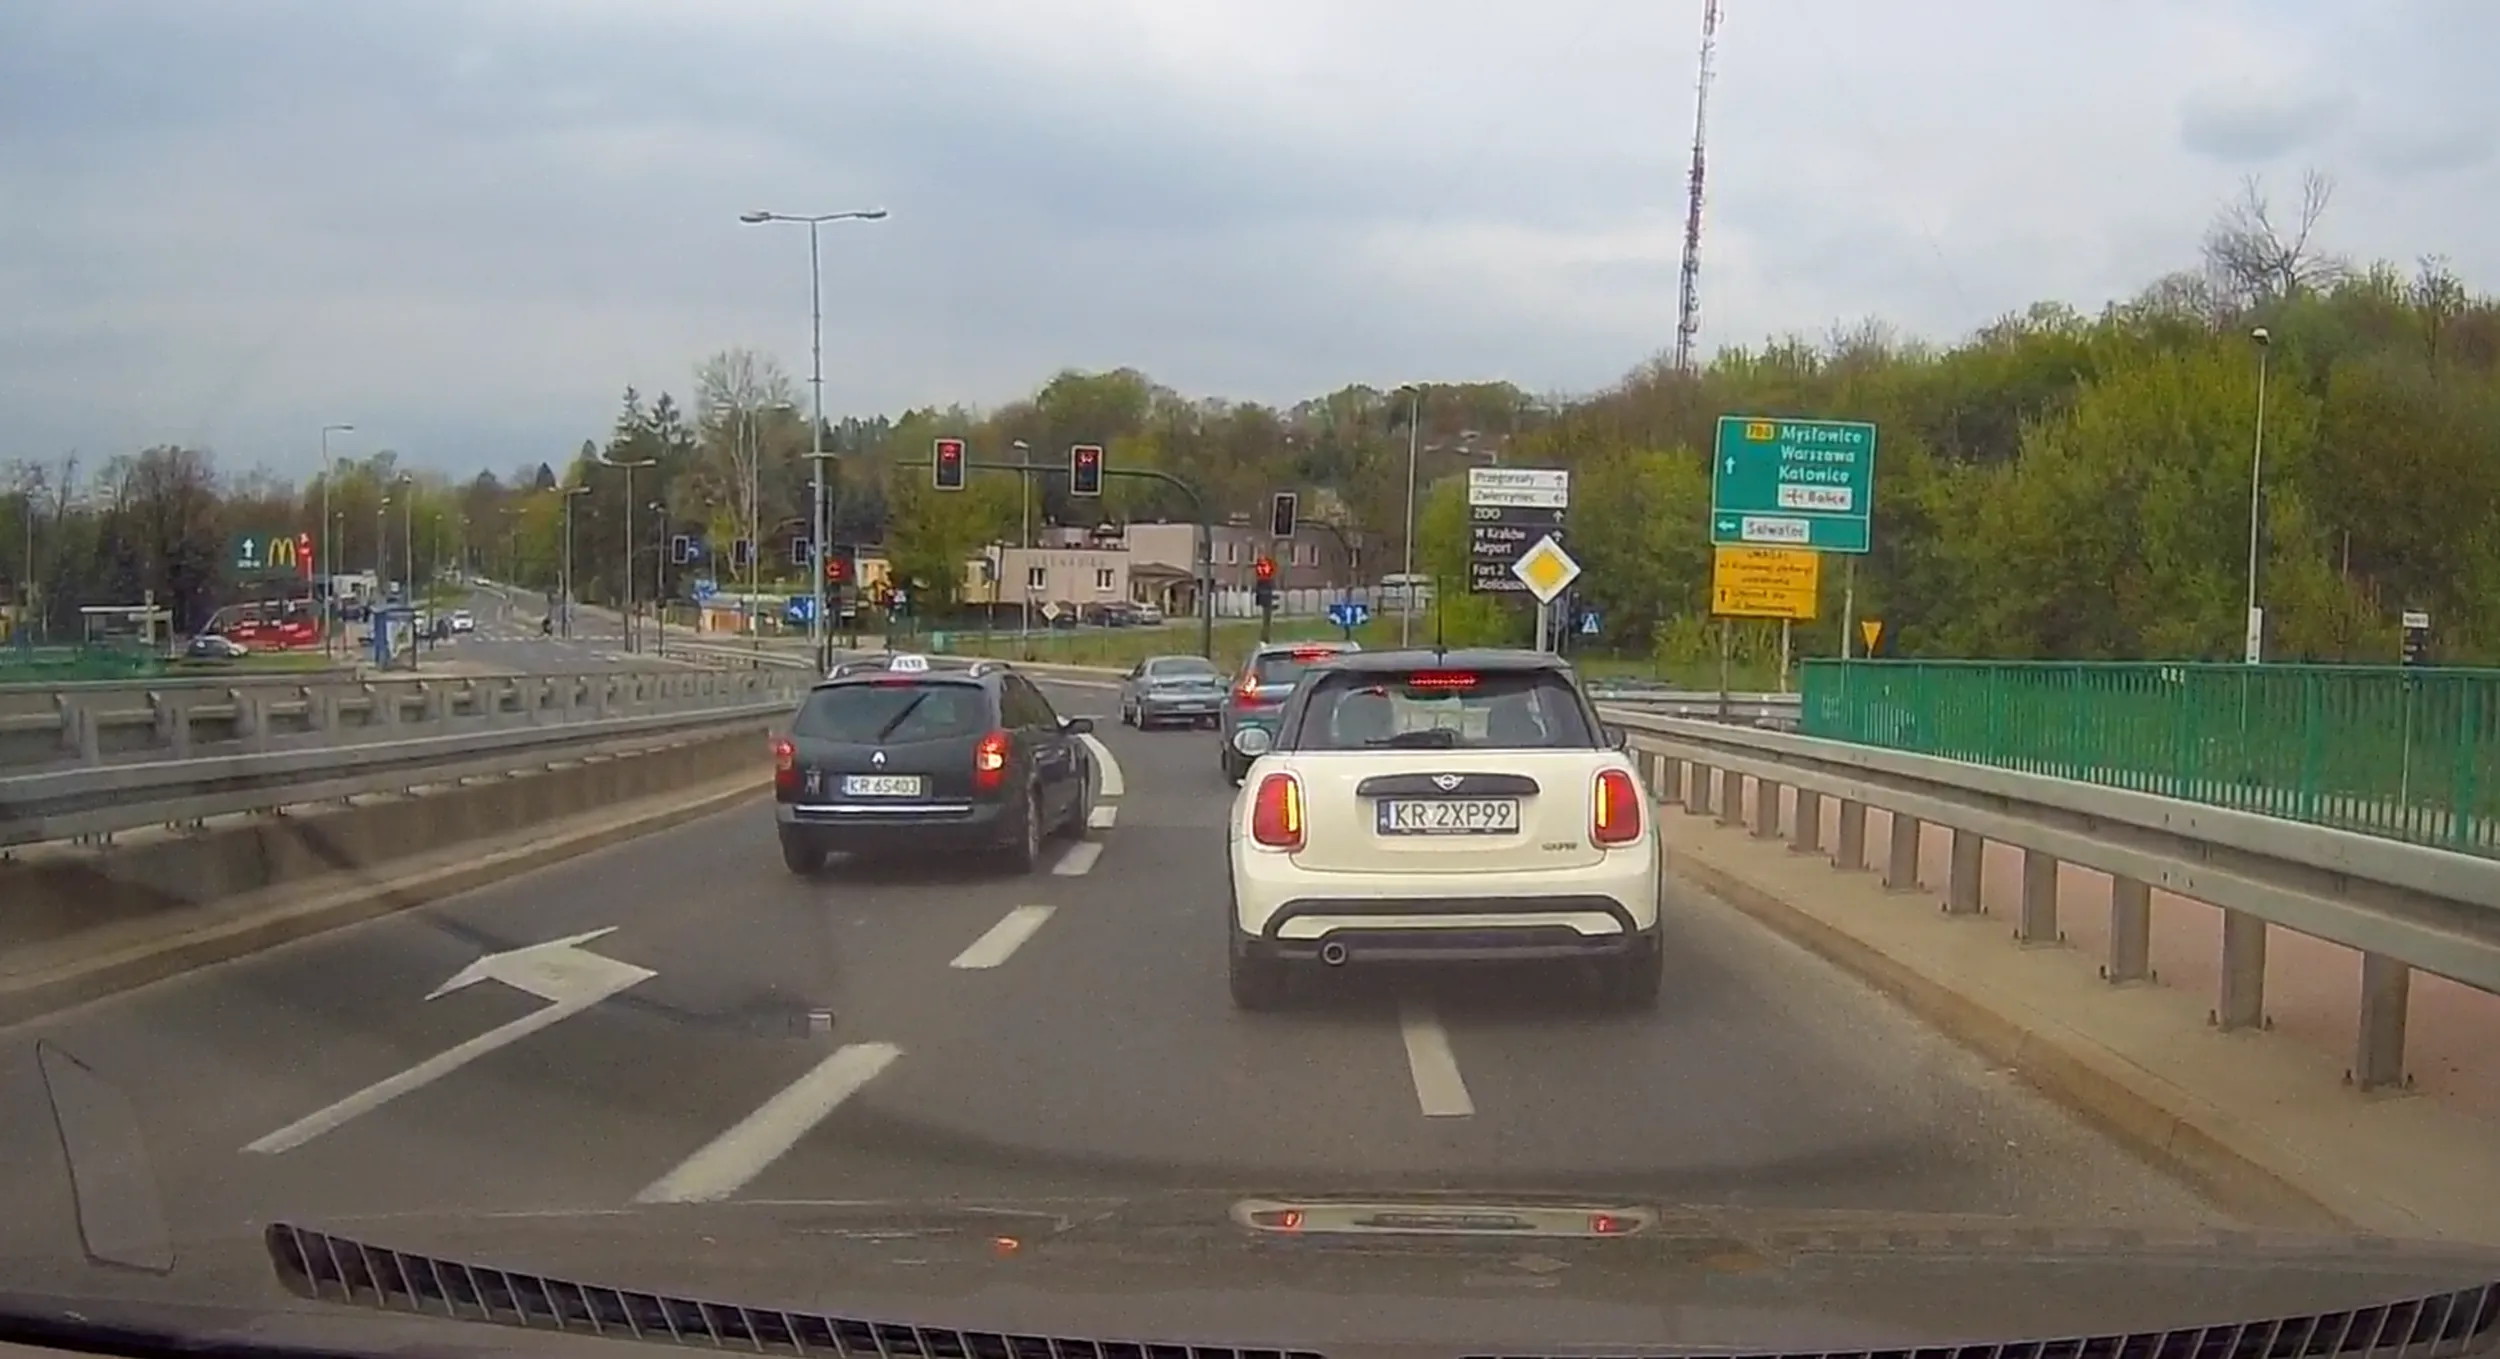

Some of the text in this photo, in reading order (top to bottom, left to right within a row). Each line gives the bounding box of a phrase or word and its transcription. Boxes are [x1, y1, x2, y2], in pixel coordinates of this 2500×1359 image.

[1780, 425, 1862, 444] Mysłowice
[1780, 445, 1855, 462] Warszawa
[1778, 465, 1850, 483] Katowice
[1474, 507, 1502, 520] ZOO
[1473, 541, 1512, 556] Airport
[1473, 563, 1505, 576] Fort 2
[849, 779, 869, 792] KR
[1395, 803, 1427, 826] KR
[1436, 803, 1511, 826] 2XP99
